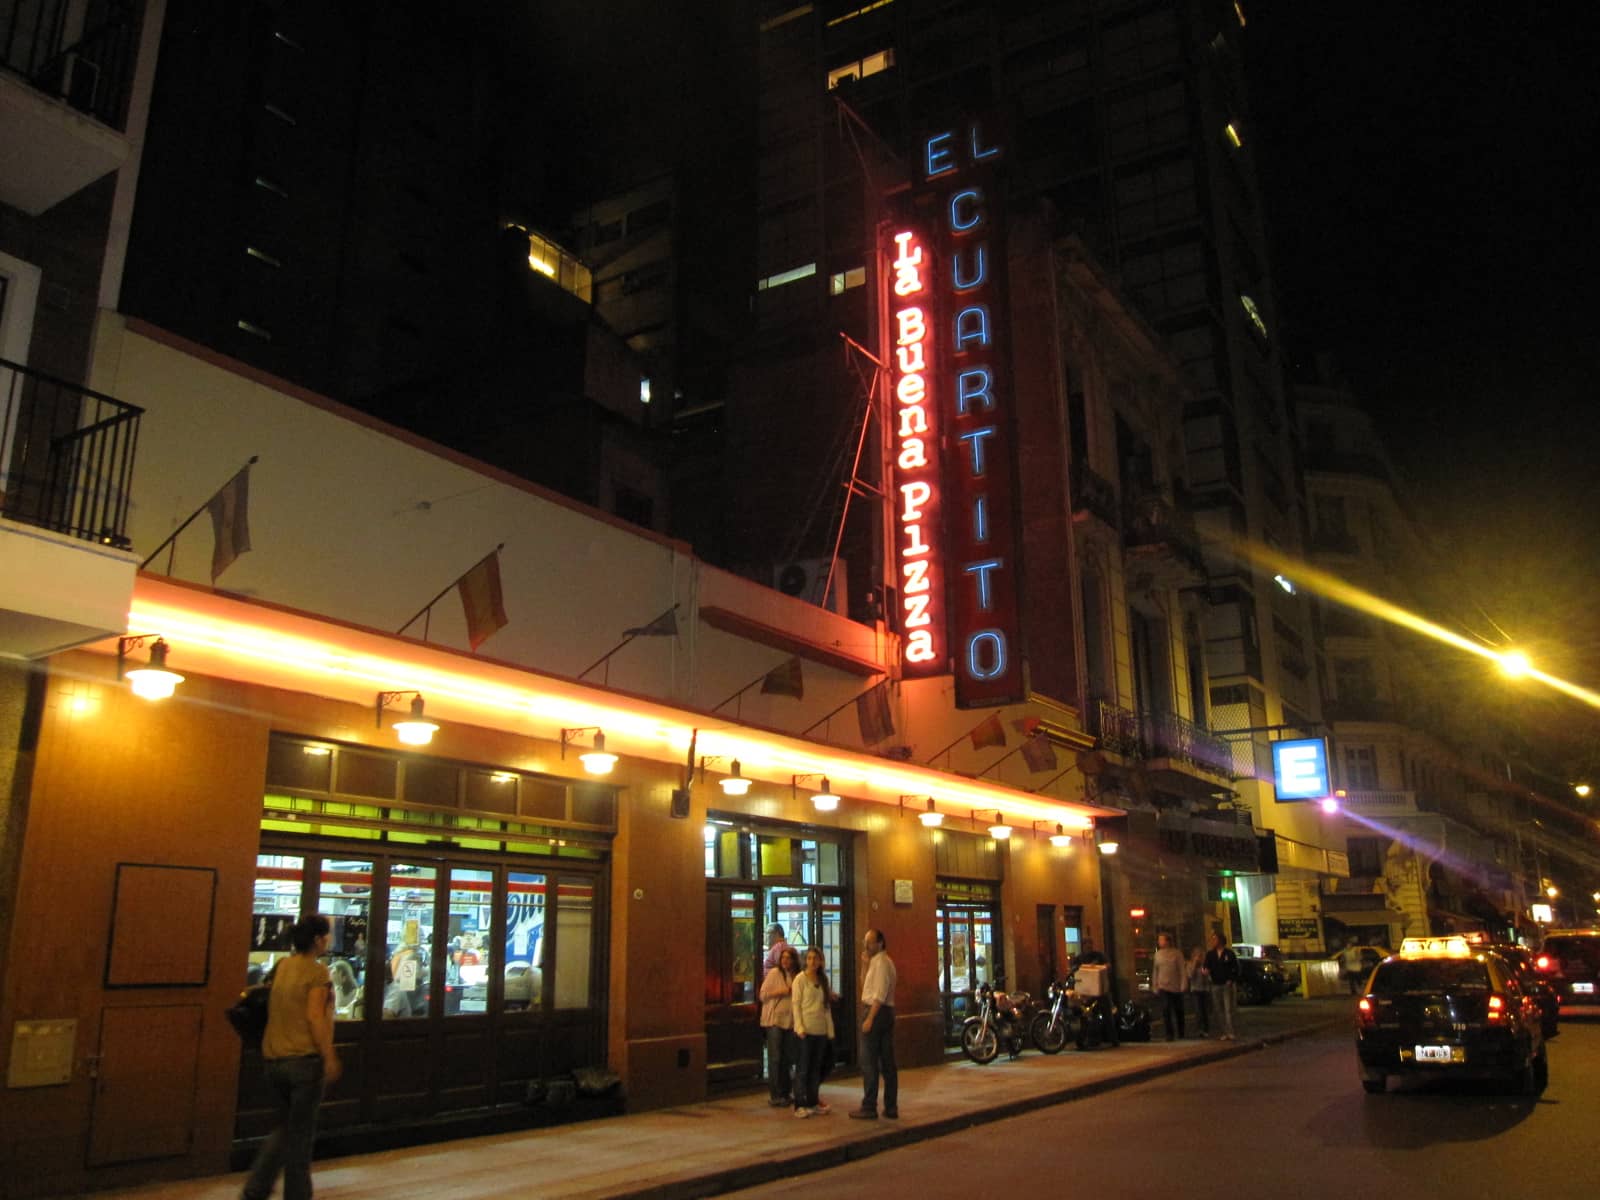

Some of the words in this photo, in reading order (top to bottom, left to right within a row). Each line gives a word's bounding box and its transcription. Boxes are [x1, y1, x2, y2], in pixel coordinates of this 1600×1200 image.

[926, 127, 999, 175] EL
[893, 231, 923, 297] La
[896, 306, 928, 470] Buena
[950, 190, 1003, 678] CUARTITO
[899, 480, 937, 664] Pizza
[1278, 745, 1322, 794] E
